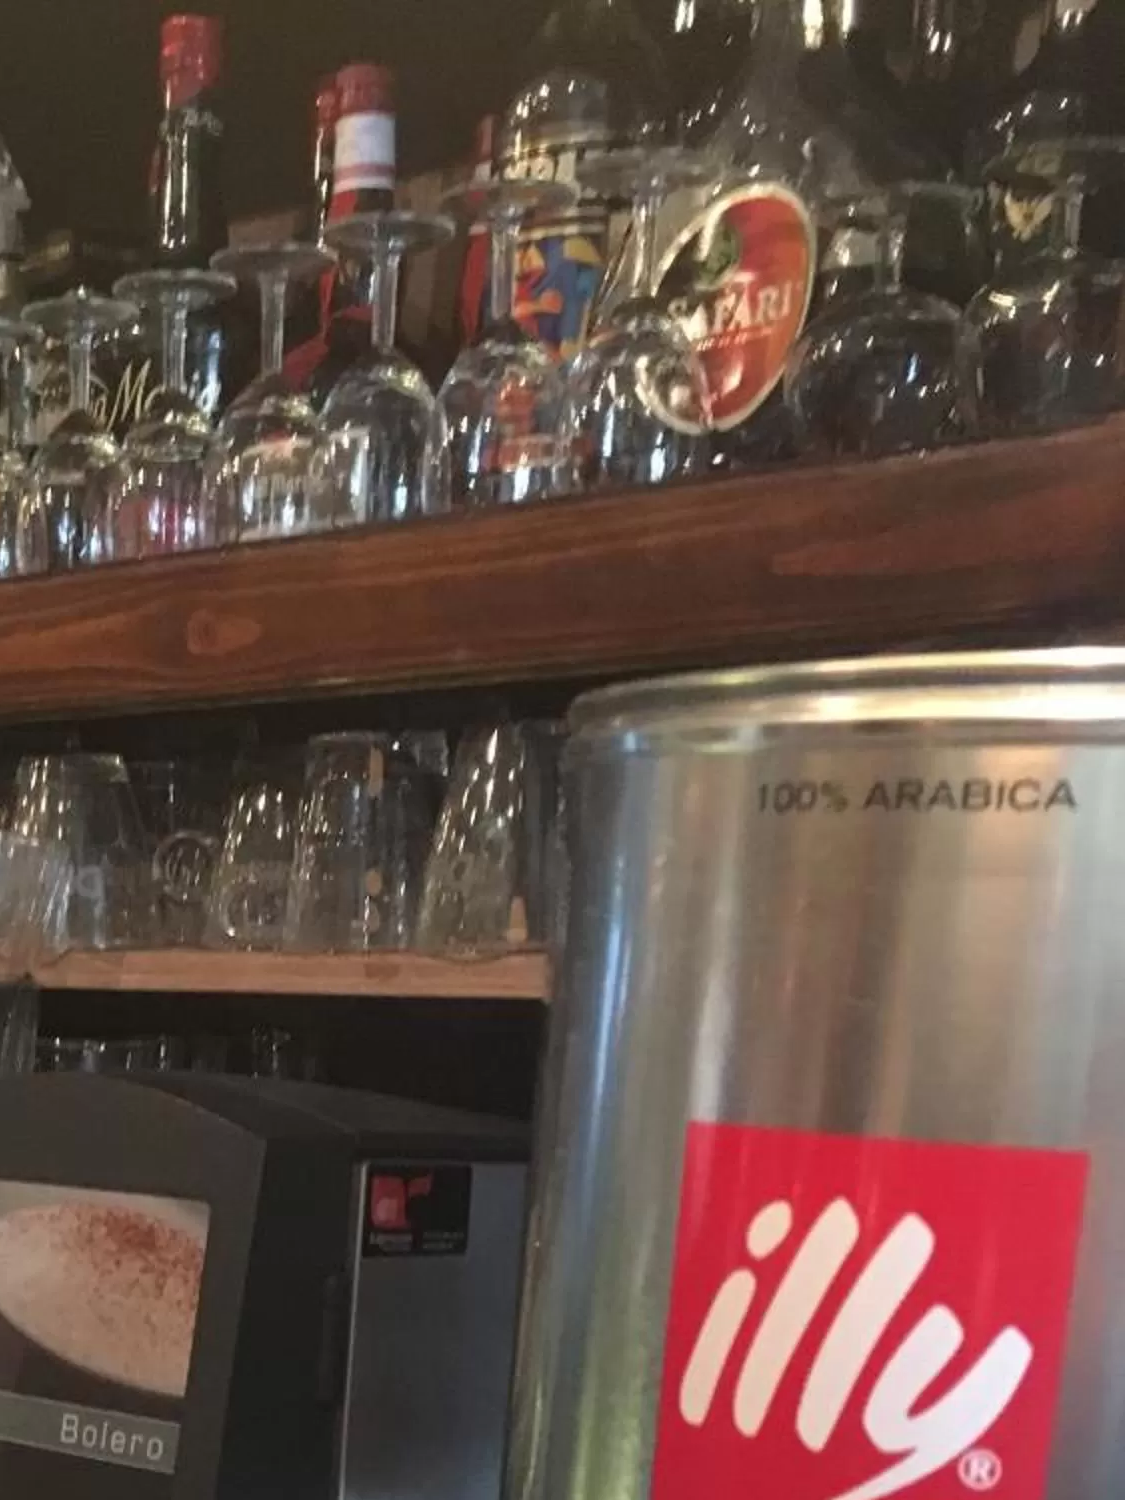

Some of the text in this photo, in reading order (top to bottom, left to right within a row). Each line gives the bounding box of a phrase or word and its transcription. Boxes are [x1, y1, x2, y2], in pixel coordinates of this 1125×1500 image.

[759, 777, 1079, 815] 100% ARABICA
[59, 1411, 165, 1461] Bolero
